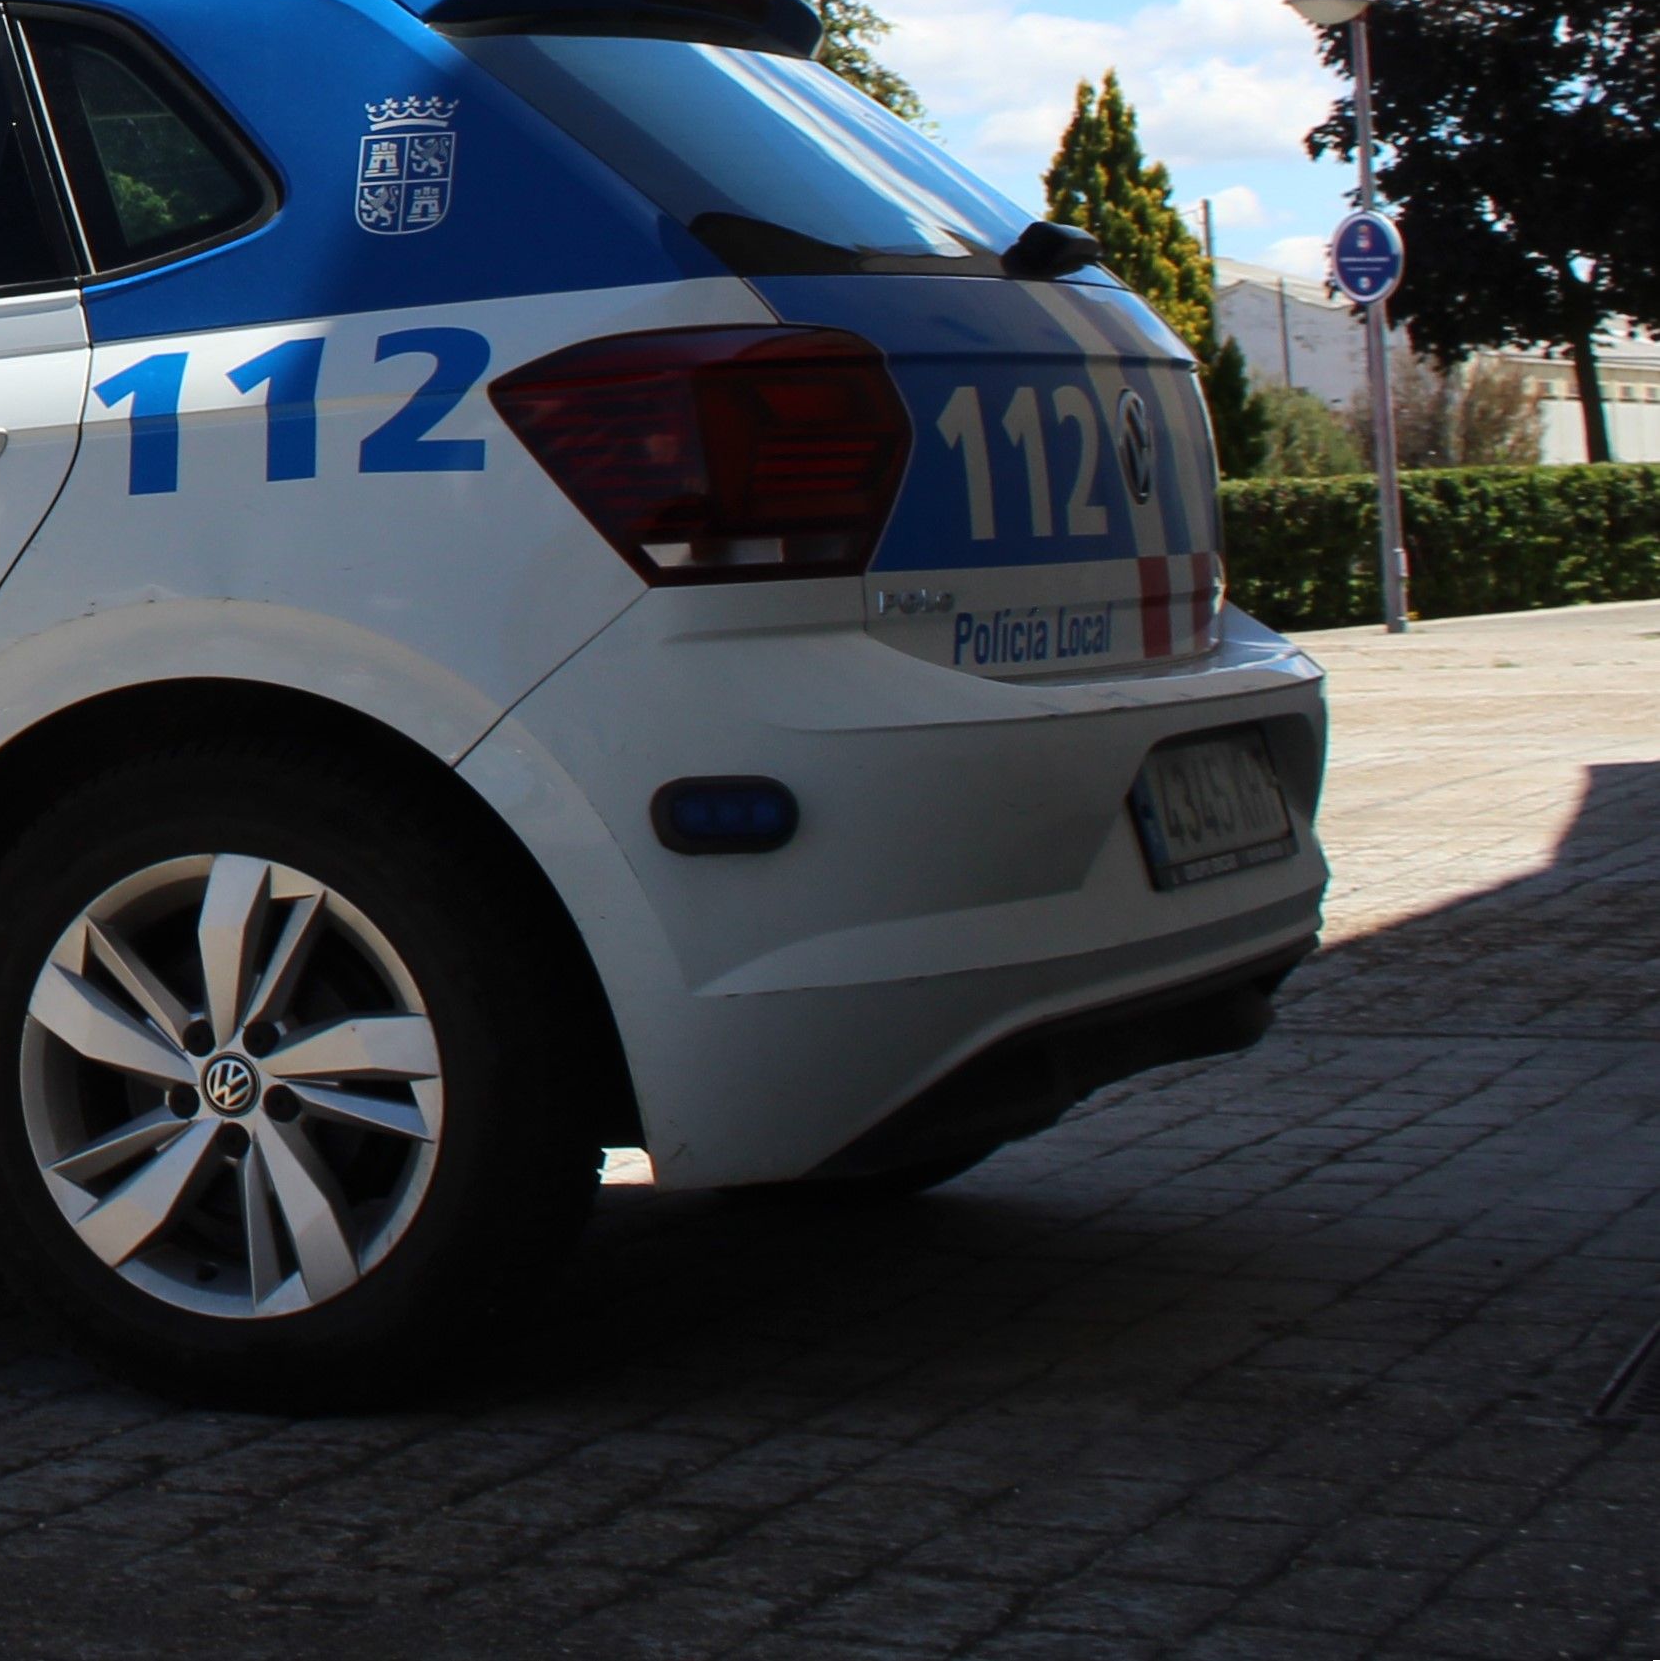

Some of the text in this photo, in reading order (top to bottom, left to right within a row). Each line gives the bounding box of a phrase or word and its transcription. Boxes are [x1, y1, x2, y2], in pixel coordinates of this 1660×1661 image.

[92, 327, 491, 495] 112
[936, 385, 1109, 540] 112
[953, 600, 1113, 665] Policía Local
